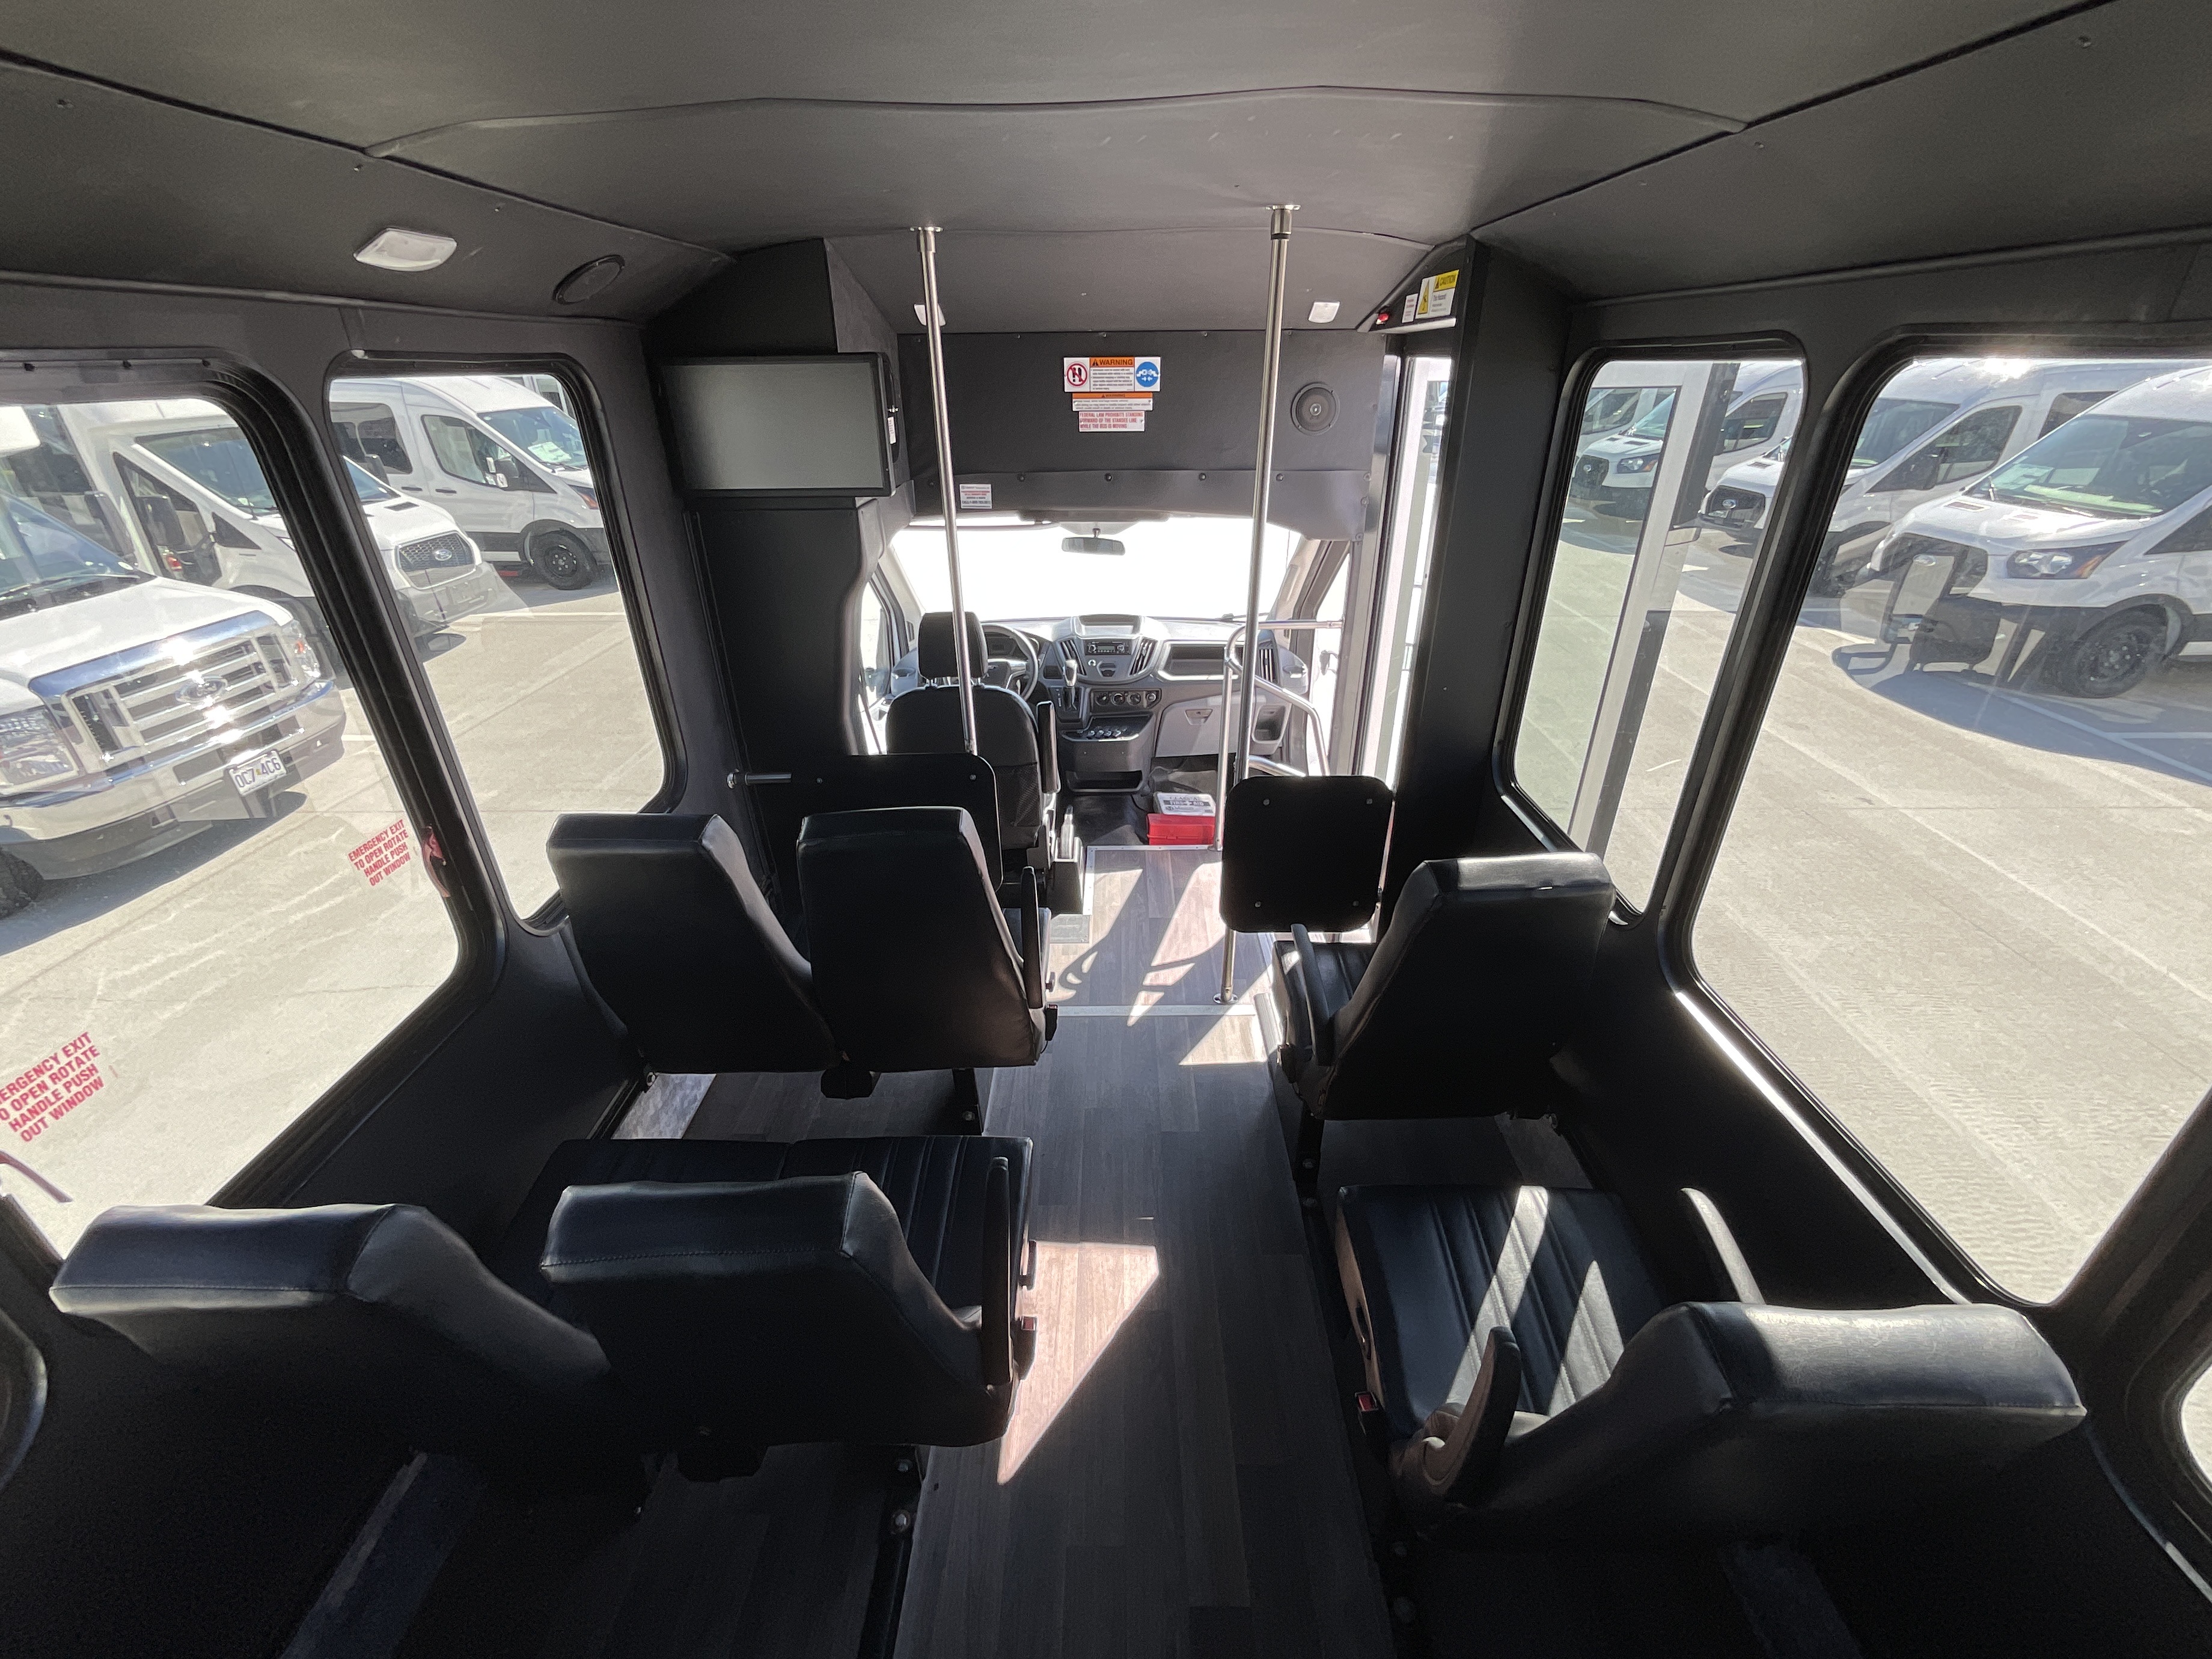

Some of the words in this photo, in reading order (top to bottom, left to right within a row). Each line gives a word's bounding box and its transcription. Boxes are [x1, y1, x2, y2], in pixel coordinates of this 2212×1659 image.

[348, 830, 390, 862] EMERGENCY
[389, 819, 405, 835] EXIT
[353, 858, 365, 870] TO
[364, 846, 383, 864] OPEN
[383, 829, 409, 851] ROTATE
[364, 854, 391, 878] HANDLE
[390, 842, 408, 860] PUSH
[369, 871, 383, 887] OUT
[382, 852, 411, 876] WINDOW
[0, 1053, 61, 1104] ERGENCY
[61, 1031, 92, 1058] EXIT
[0, 1108, 10, 1121] O
[10, 1080, 50, 1111] OPEN
[48, 1045, 100, 1085] ROTATE
[8, 1089, 64, 1132] HANDLE
[63, 1063, 99, 1093] PUSH
[20, 1116, 49, 1142] OUT
[49, 1076, 104, 1120] WINDOW
